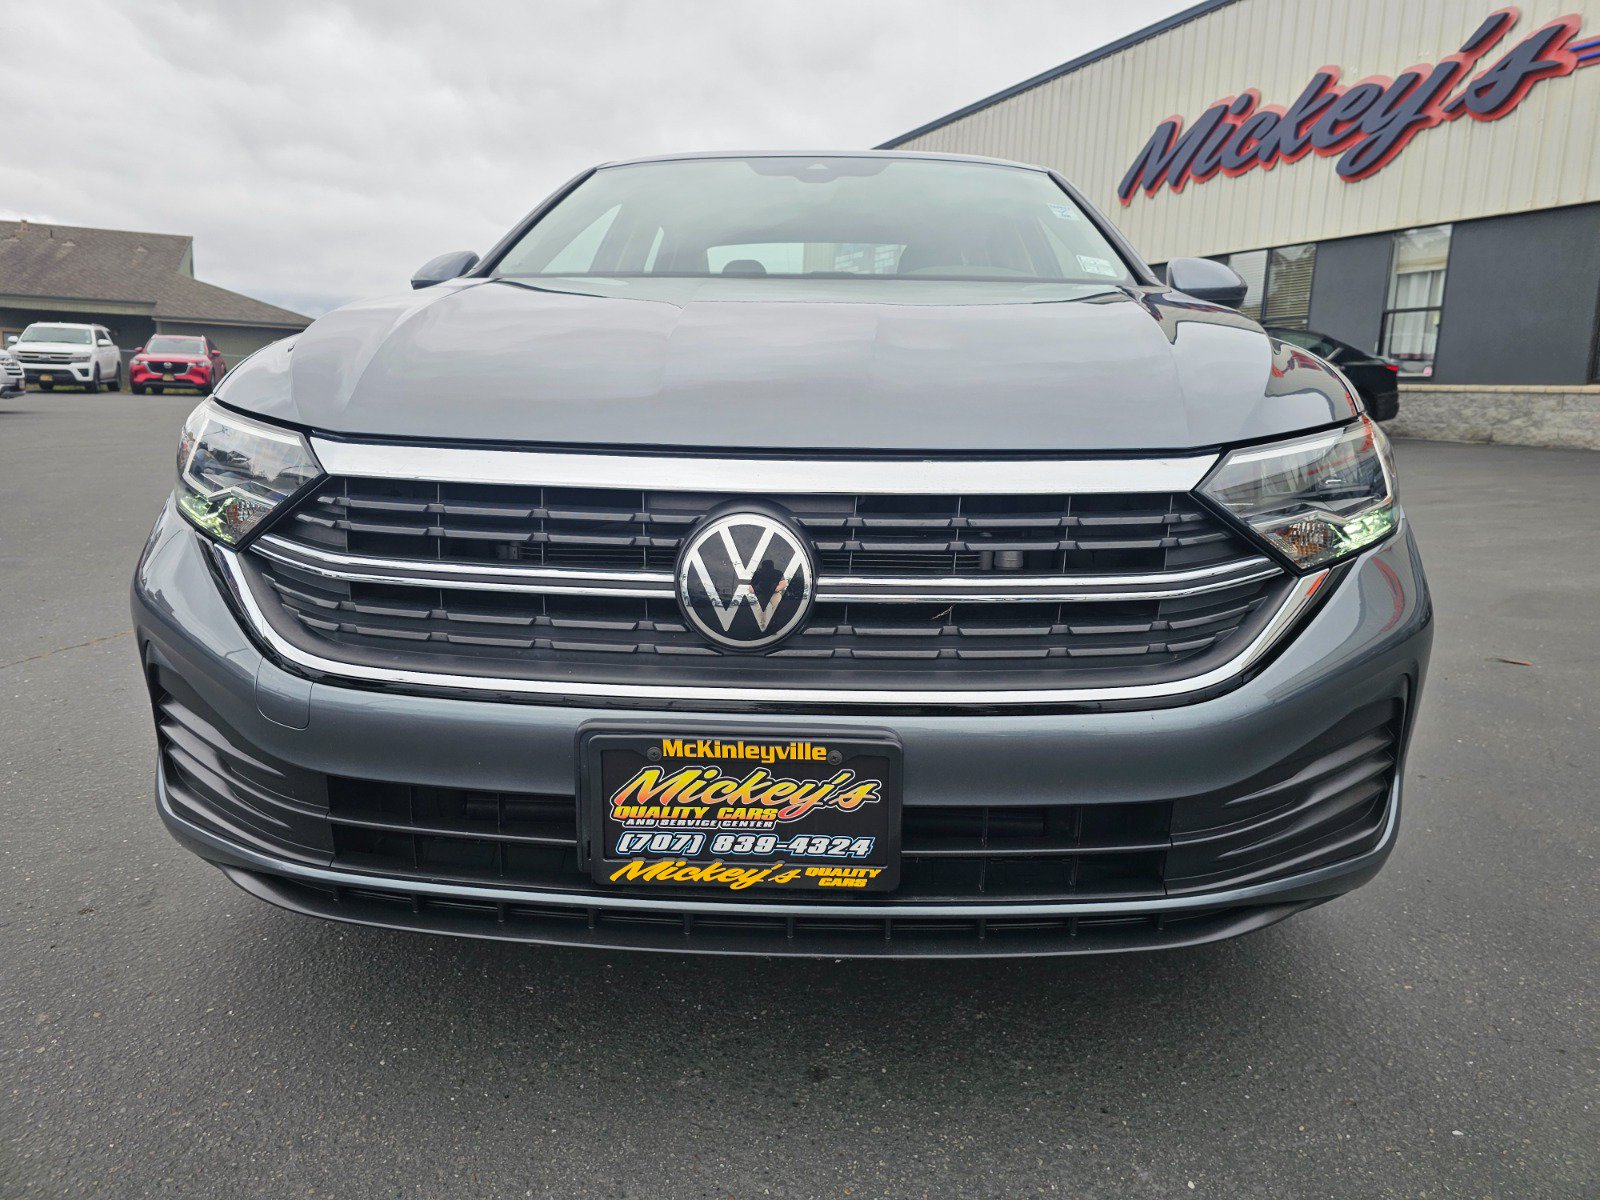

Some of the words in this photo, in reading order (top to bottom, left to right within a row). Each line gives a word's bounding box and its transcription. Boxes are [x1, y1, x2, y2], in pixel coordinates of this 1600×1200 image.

[1117, 8, 1578, 206] Mickey's
[662, 739, 828, 763] McKinleyville
[612, 766, 879, 820] Mickey's
[613, 805, 709, 820] QUALITY
[717, 806, 778, 821] CARS
[625, 818, 656, 827] AND
[659, 818, 718, 828] SERVICE
[721, 819, 774, 829] CENTER
[618, 832, 704, 854] (707)
[711, 833, 873, 857] 839-4324
[610, 860, 801, 890] Mickey's
[805, 866, 881, 878] QUALITY
[818, 876, 867, 888] CARS
